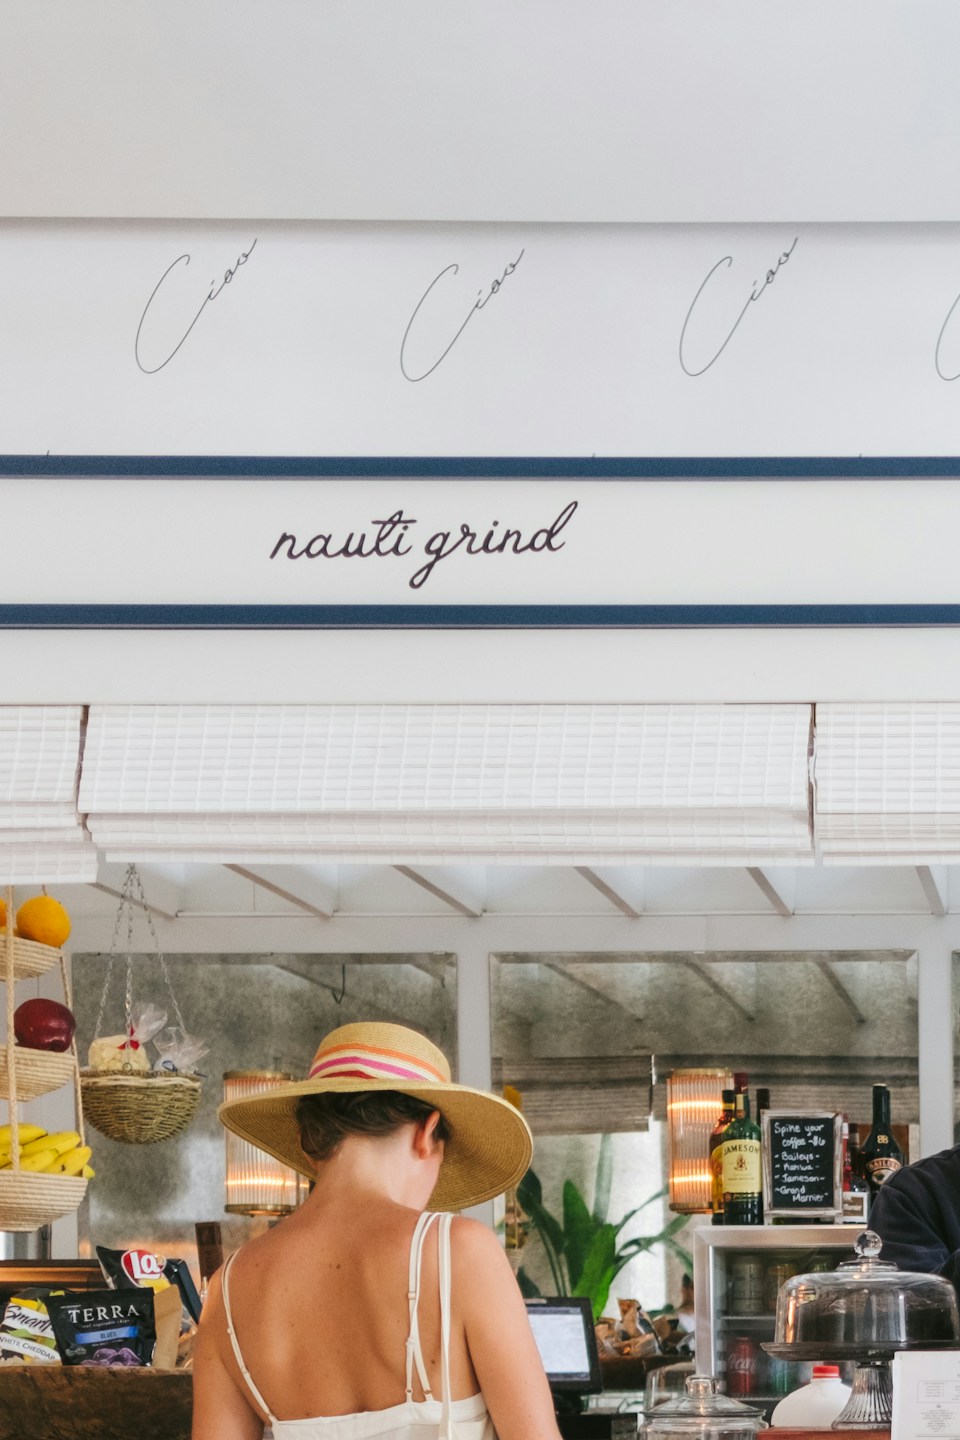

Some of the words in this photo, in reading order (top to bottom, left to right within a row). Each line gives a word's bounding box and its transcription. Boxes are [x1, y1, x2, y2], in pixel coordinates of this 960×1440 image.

[135, 238, 257, 374] Ciao
[401, 248, 525, 382] Ciao
[679, 237, 798, 377] Ciao
[270, 510, 417, 560] nauti
[409, 501, 578, 589] grind
[782, 1137, 806, 1149] coffee
[804, 1124, 824, 1136] your
[723, 1144, 760, 1156] JAMESON
[129, 1252, 163, 1279] La
[67, 1305, 140, 1324] TERRA
